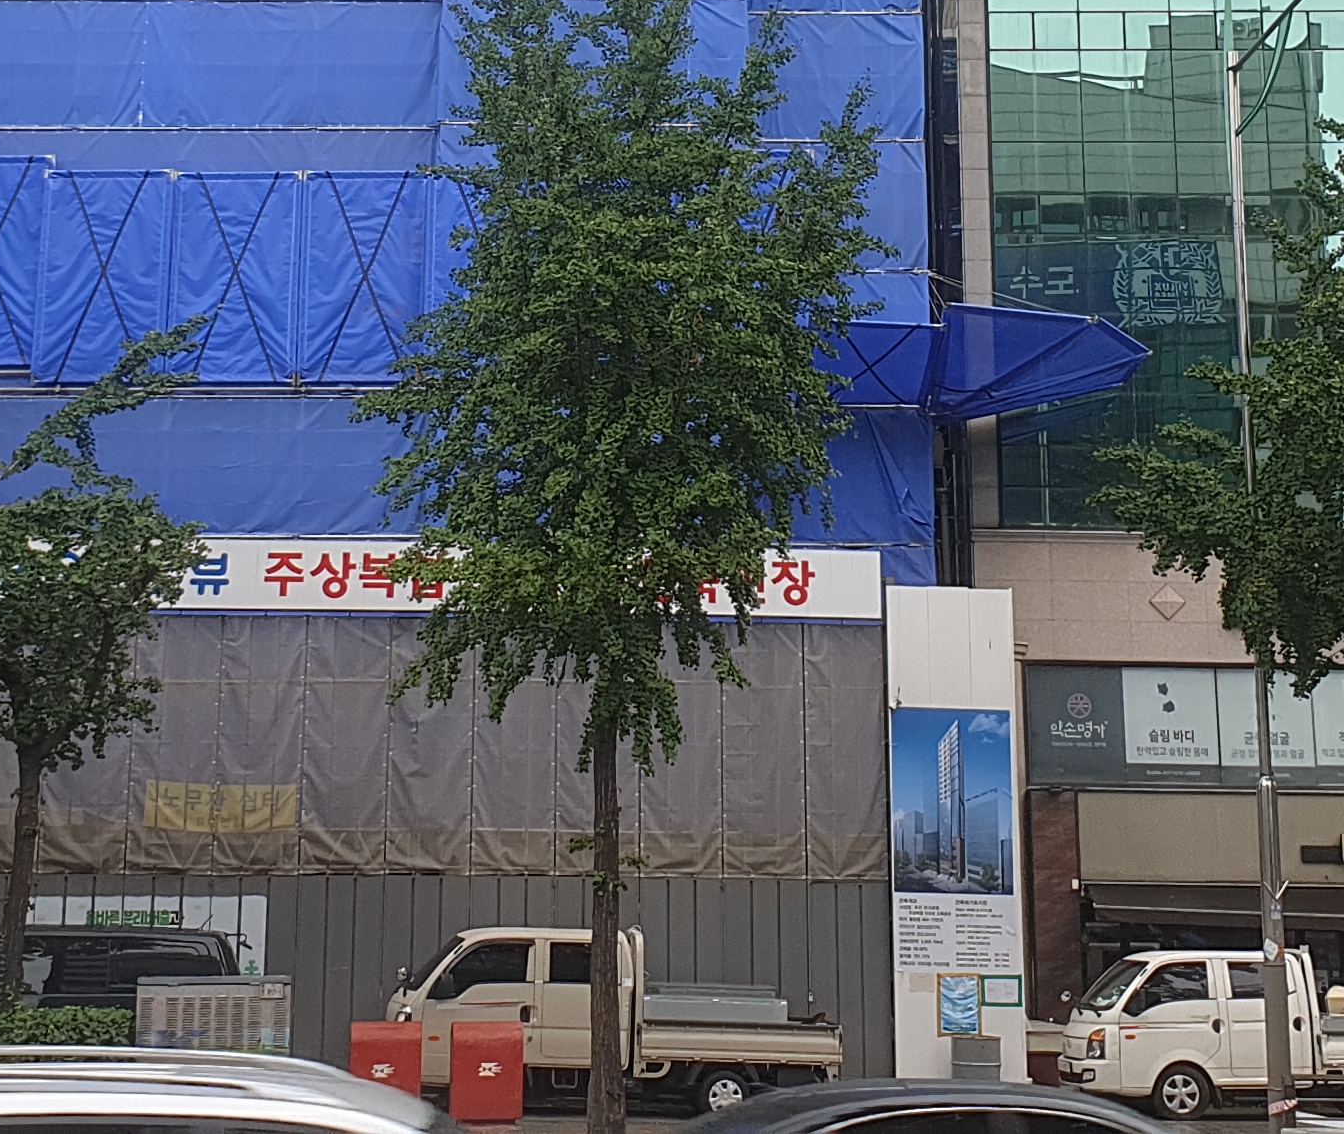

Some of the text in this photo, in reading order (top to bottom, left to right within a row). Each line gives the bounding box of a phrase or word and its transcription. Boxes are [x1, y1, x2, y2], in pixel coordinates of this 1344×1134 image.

[1050, 720, 1105, 739] 약손명가
[1148, 728, 1195, 744] 슬림 바디
